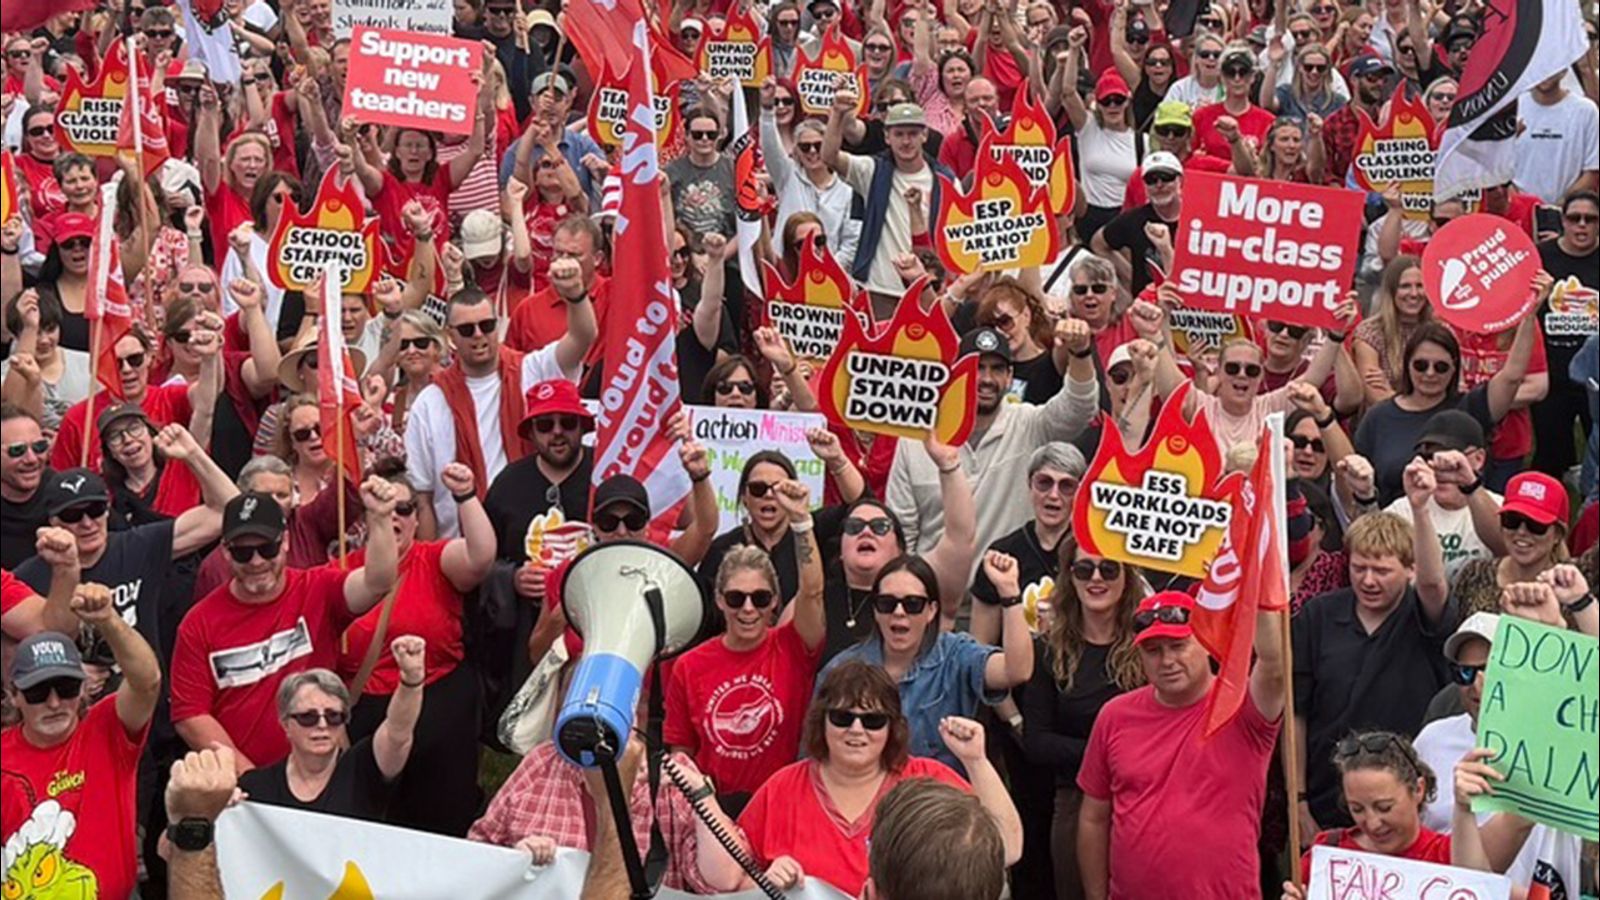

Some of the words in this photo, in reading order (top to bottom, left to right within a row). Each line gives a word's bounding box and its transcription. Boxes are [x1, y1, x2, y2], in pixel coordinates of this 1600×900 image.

[360, 31, 470, 68] Support
[708, 44, 755, 54] UNPAID
[711, 56, 751, 66] STAND
[384, 67, 440, 90] new
[711, 67, 751, 77] DOWN
[805, 71, 854, 84] SCHOL
[84, 101, 122, 112] RISIN
[350, 87, 466, 121] teachers
[603, 91, 668, 110] TEARS
[808, 96, 833, 106] CRIS
[61, 114, 118, 127] CLASSR
[600, 107, 663, 125] BURG
[72, 129, 117, 140] VIOLE
[991, 148, 1050, 163] UPAID
[1377, 141, 1426, 152] RISING
[1358, 153, 1437, 167] CLASSROO
[976, 200, 1011, 219] ESP
[1217, 181, 1324, 229] More
[947, 214, 1044, 239] WORKLOADS
[290, 230, 362, 249] SCHOOL
[965, 236, 993, 251] ARE
[997, 231, 1030, 245] NOT
[1187, 218, 1343, 271] in-class
[1462, 228, 1507, 266] Proud
[283, 248, 363, 267] STAFFING
[982, 248, 1017, 262] SAFE
[1471, 260, 1488, 275] to
[1487, 246, 1508, 262] be
[293, 266, 348, 282] CRS
[1479, 250, 1530, 290] public.
[1178, 268, 1341, 313] support
[771, 304, 846, 324] DROWNI
[780, 322, 797, 335] IN
[801, 324, 839, 341] ADM
[792, 340, 831, 356] WOR
[597, 337, 646, 428] roud
[636, 301, 668, 336] to
[851, 355, 945, 383] UNPAID
[854, 378, 935, 402] STAND
[850, 399, 933, 425] DOWN
[696, 413, 758, 440] action
[760, 413, 805, 442] Minis
[1147, 476, 1181, 494] ESS
[1096, 486, 1227, 522] WORKLOADS
[1110, 511, 1150, 530] ARE
[1155, 517, 1200, 538] NOT
[1130, 534, 1178, 555] SAFE
[1500, 624, 1598, 682] DON
[1485, 681, 1504, 714] A
[1329, 859, 1401, 900] FAIR
